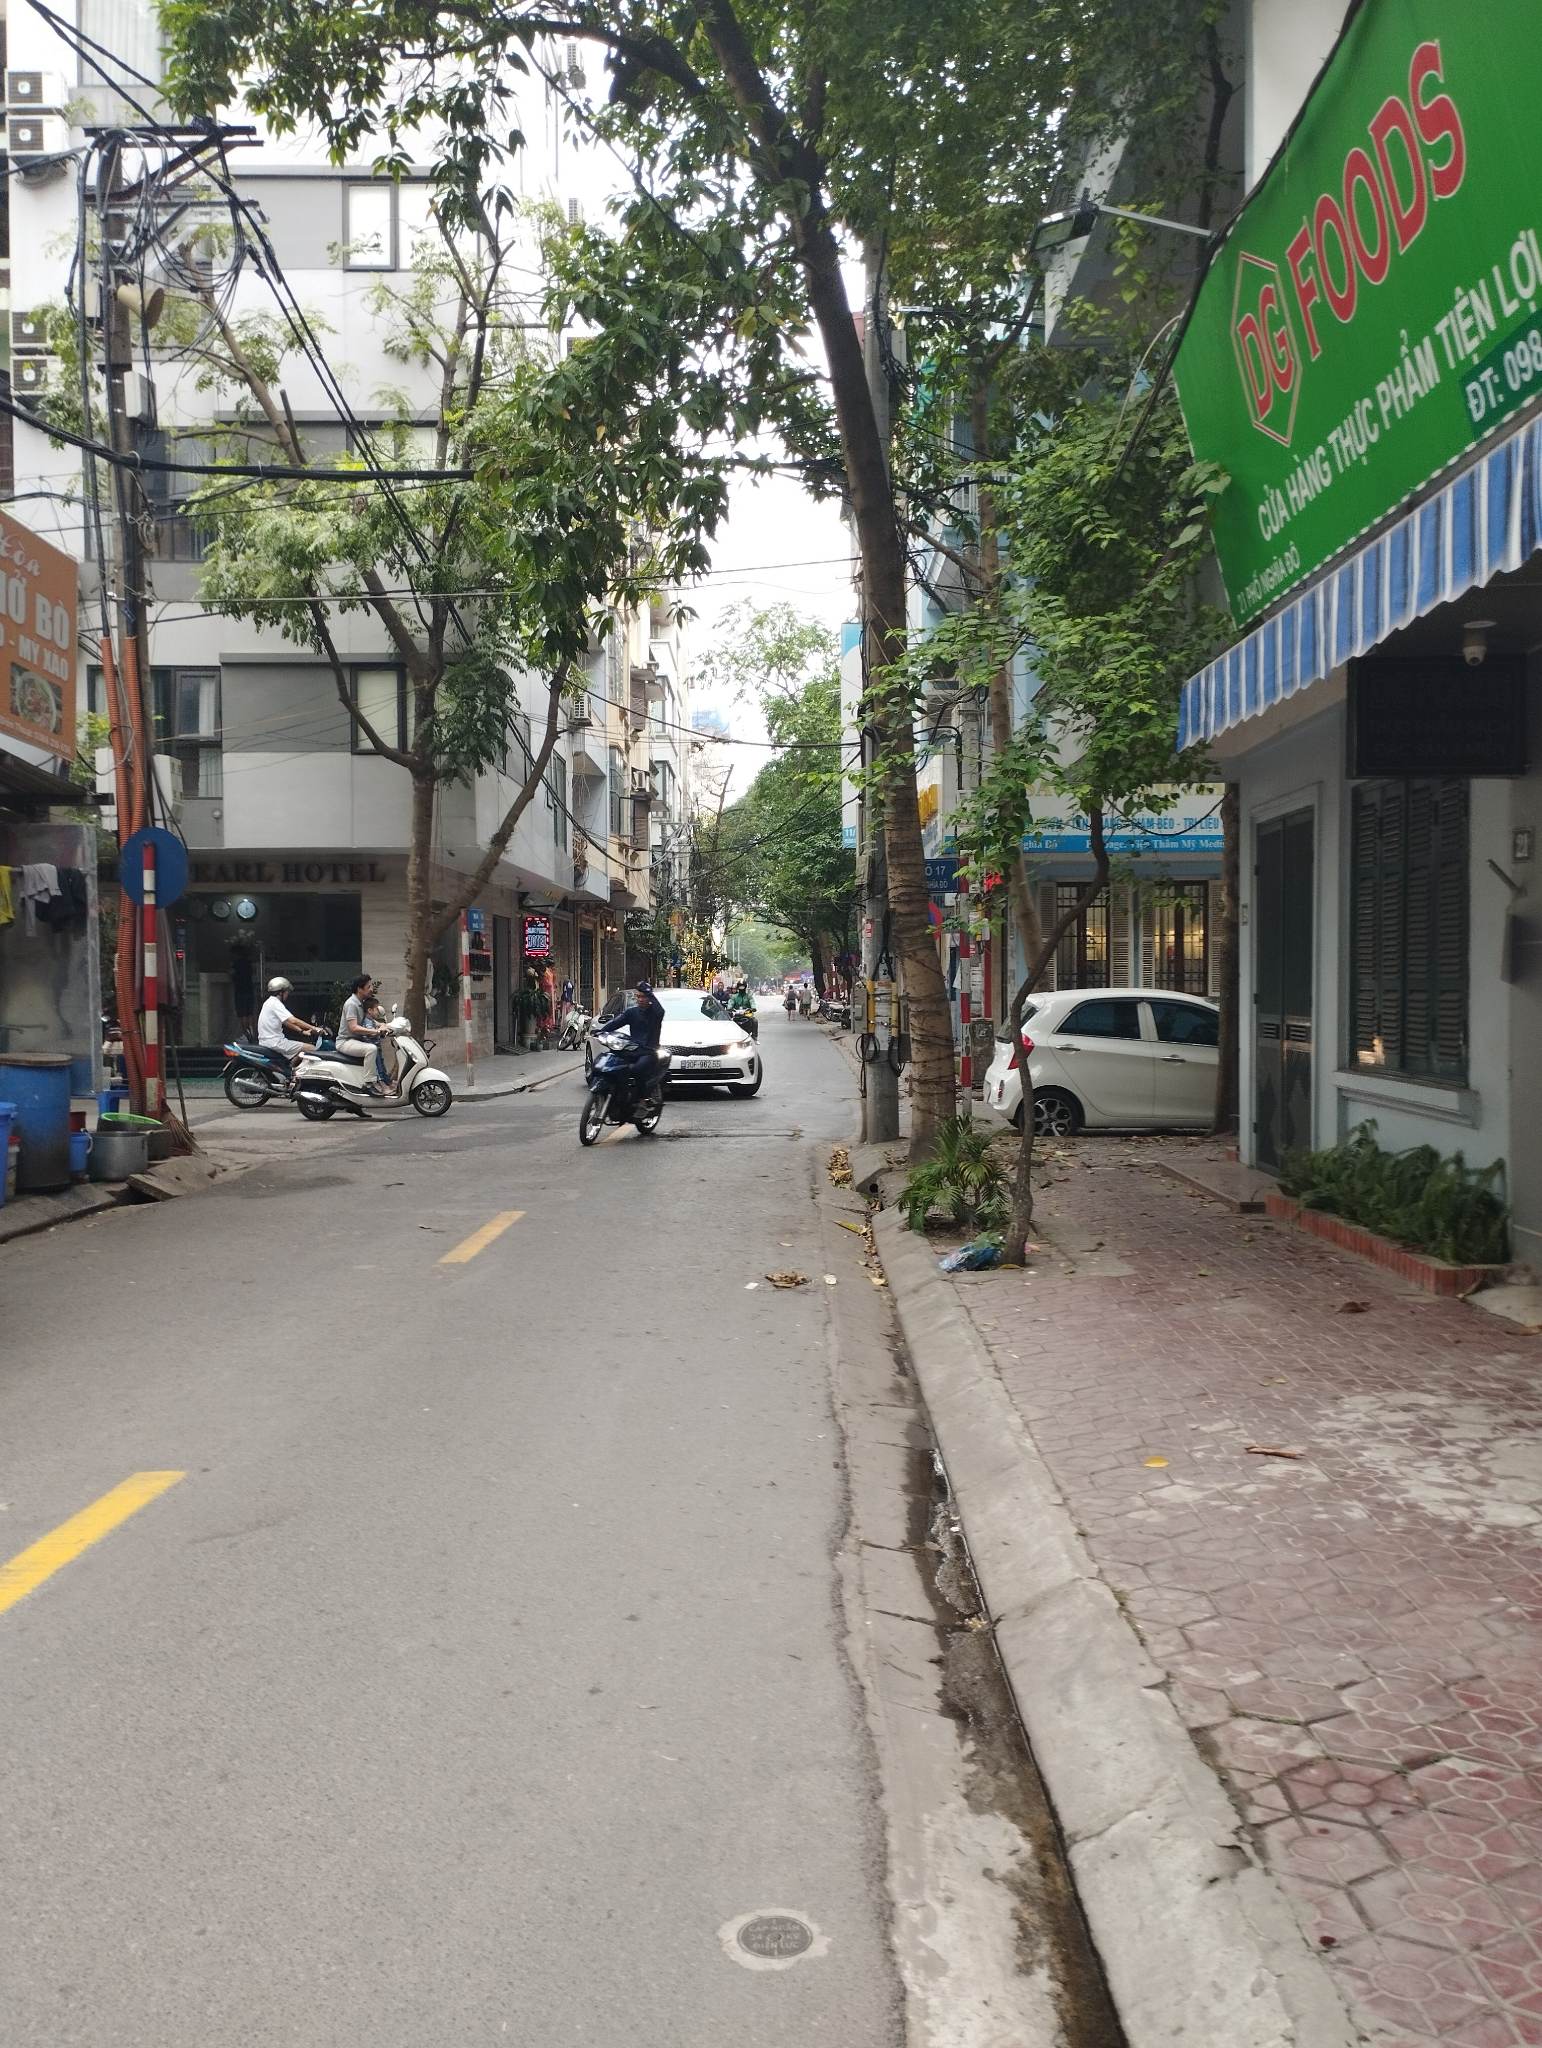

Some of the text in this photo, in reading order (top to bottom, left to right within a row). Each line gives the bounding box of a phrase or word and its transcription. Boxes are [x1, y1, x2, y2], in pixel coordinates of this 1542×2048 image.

[1238, 39, 1466, 422] DG FOODS
[1258, 229, 1542, 541] CỬA HÀNG THỰC PHẨM TIỆN LỢI
[1465, 367, 1504, 422] ĐT:
[36, 592, 70, 650] BÒ
[281, 862, 386, 883] HOTEL
[935, 866, 946, 876] 17
